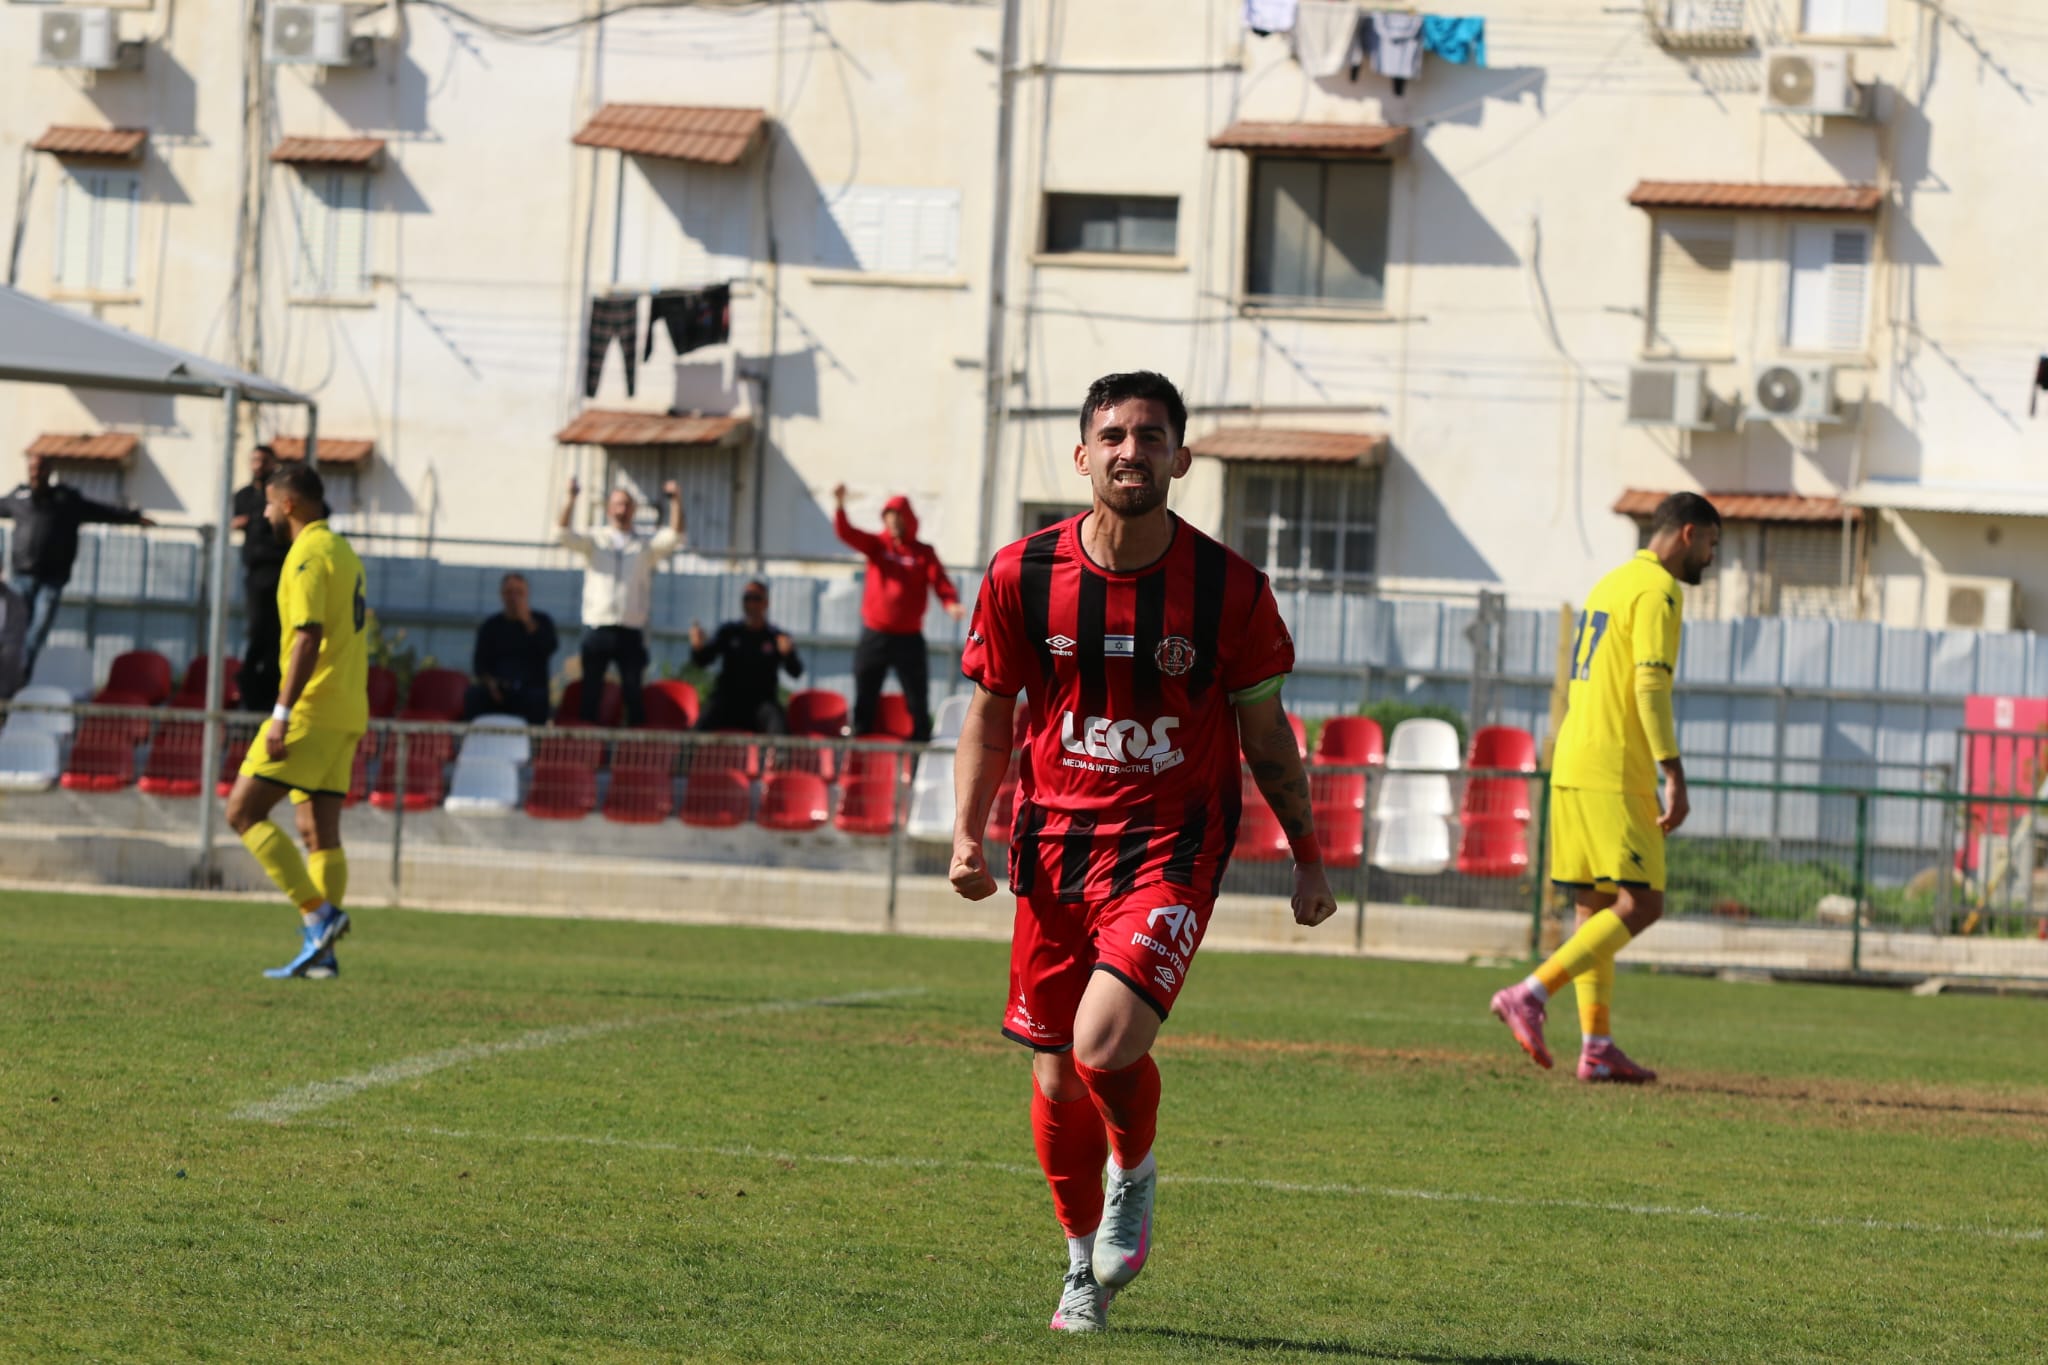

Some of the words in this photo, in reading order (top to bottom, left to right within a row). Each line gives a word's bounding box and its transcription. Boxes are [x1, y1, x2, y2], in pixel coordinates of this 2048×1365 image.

[1061, 710, 1180, 763] LEOS
[1062, 757, 1088, 770] MEDIA
[1087, 762, 1096, 771] &
[1096, 763, 1150, 774] INTERACTIVE
[1146, 904, 1198, 957] AS
